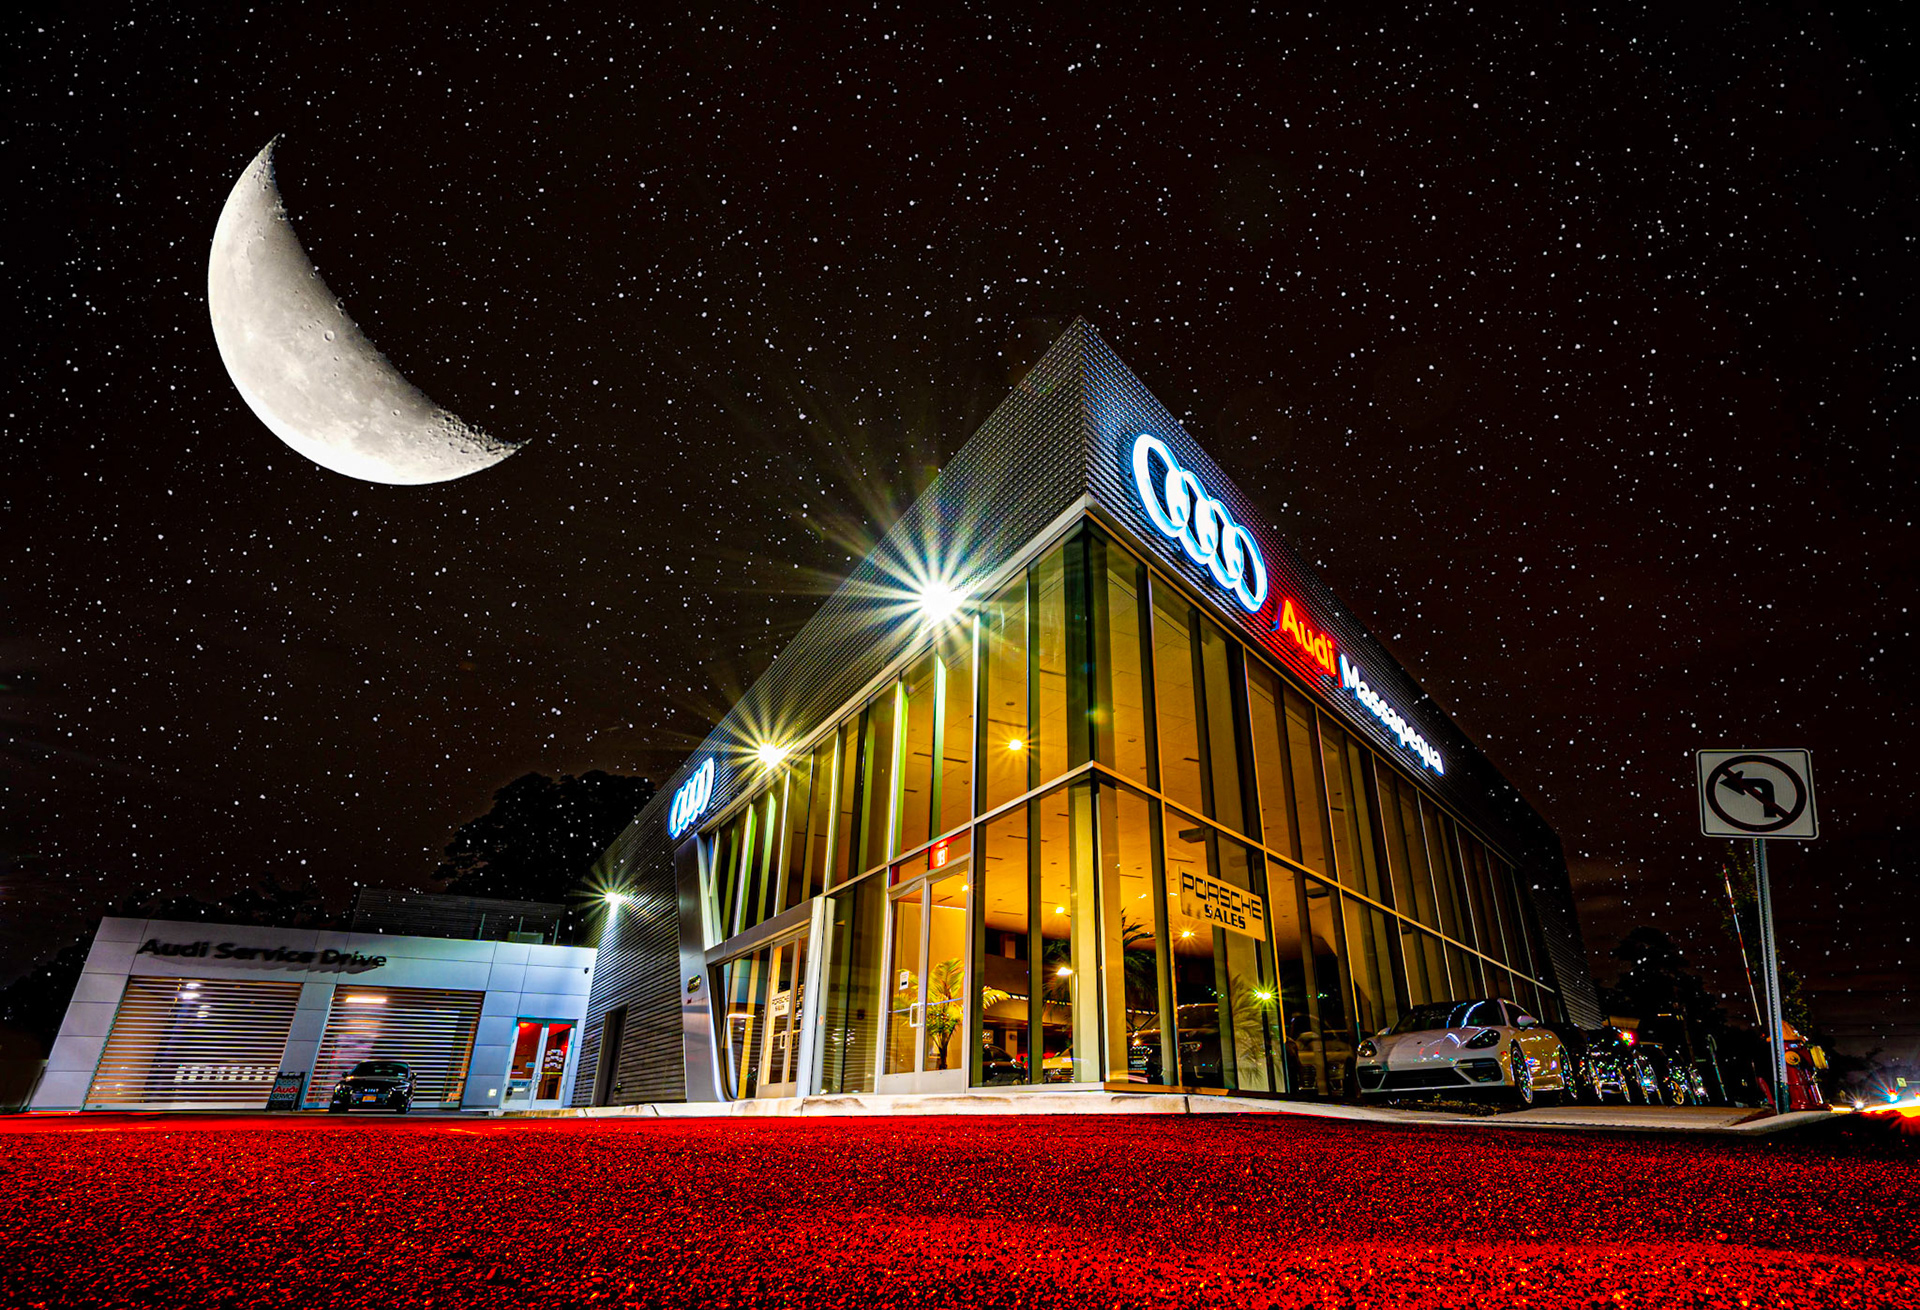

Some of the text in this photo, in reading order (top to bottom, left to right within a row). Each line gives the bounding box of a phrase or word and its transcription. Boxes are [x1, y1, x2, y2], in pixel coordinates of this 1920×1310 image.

[1281, 599, 1445, 775] Audi Massapequa
[1182, 872, 1262, 920] PORSCHE
[1204, 904, 1246, 929] SALES
[137, 938, 387, 967] Audi Service Drive
[273, 1086, 299, 1094] Audi
